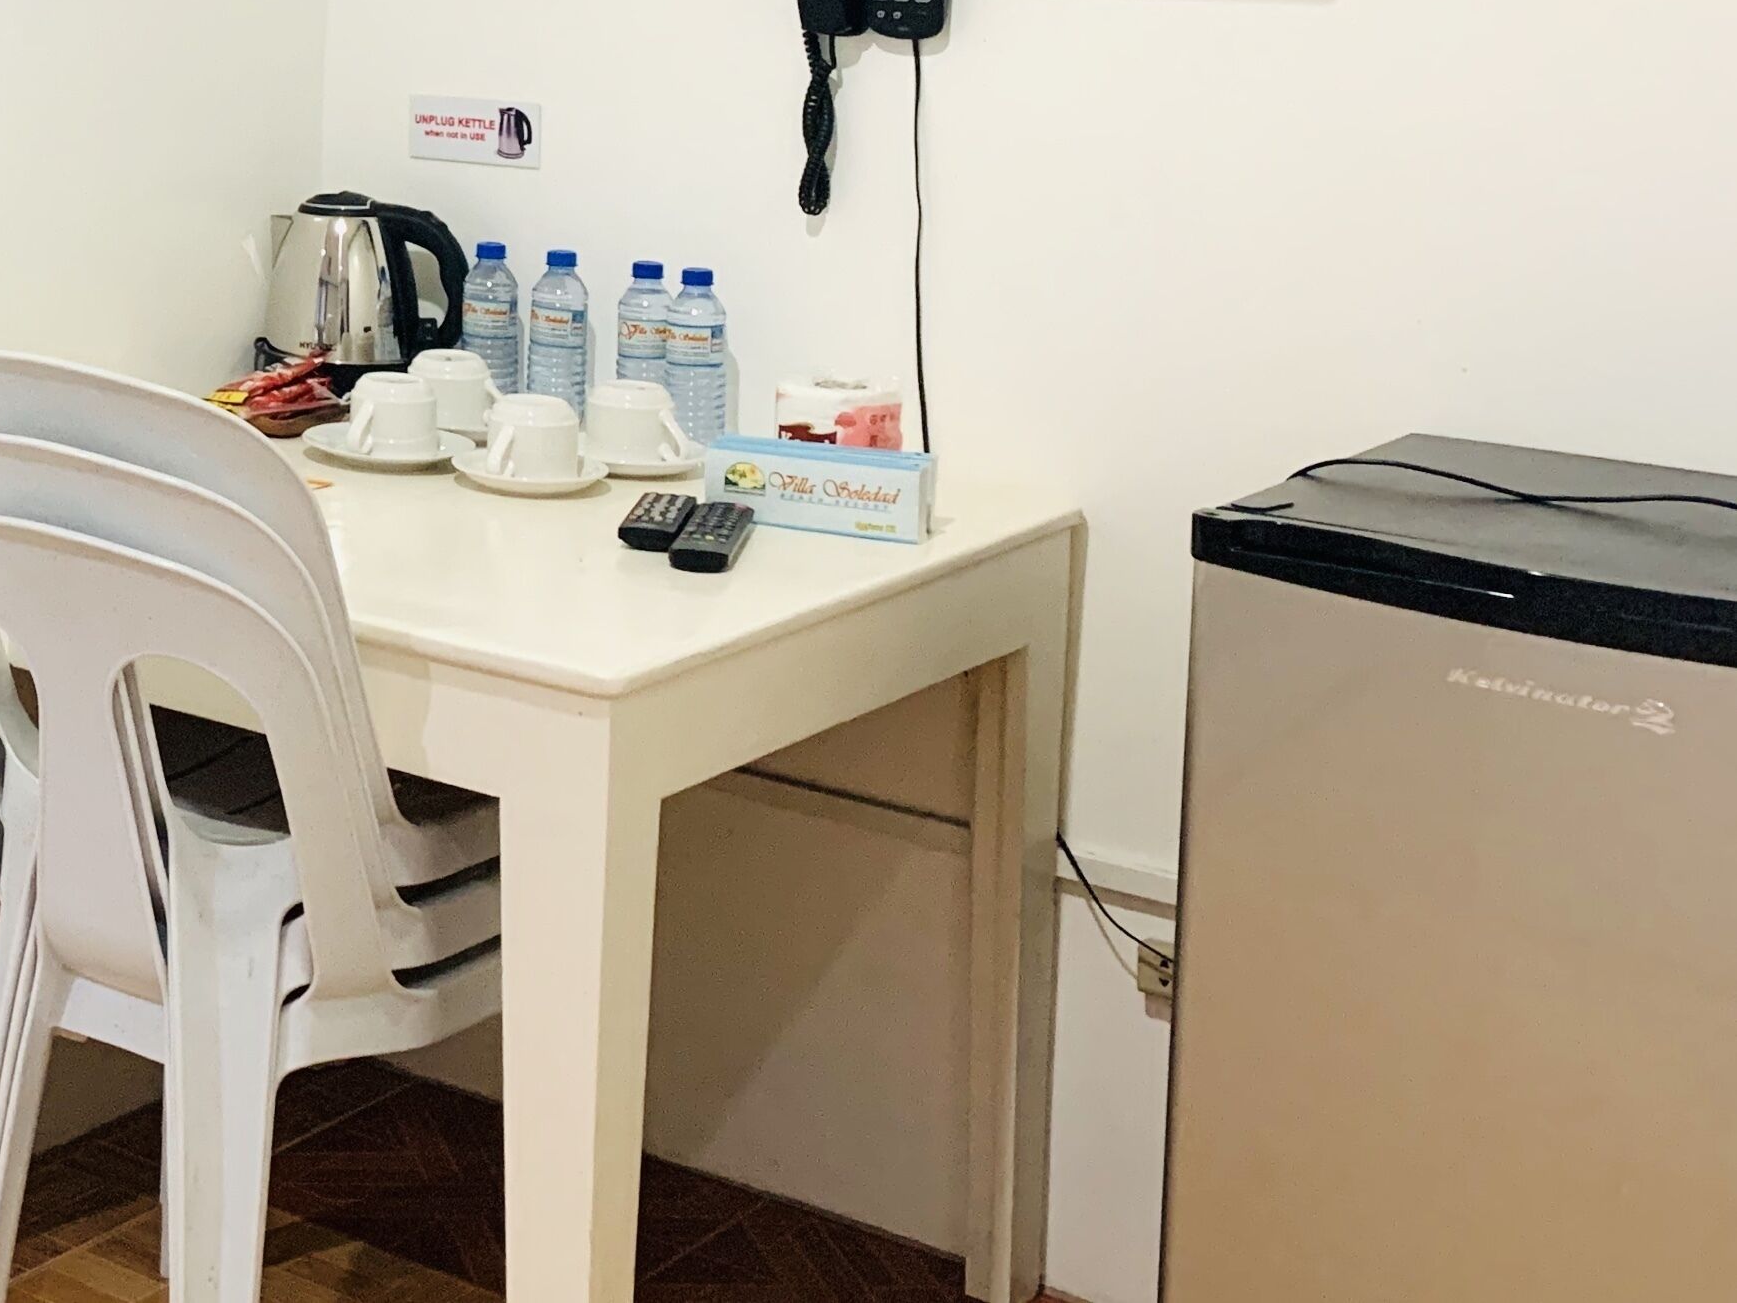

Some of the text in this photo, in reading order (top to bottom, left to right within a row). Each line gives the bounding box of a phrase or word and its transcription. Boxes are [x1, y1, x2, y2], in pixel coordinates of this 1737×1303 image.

[415, 114, 495, 130] UNPLUG KETTLE
[446, 131, 459, 139] not
[469, 132, 486, 141] USE
[768, 471, 901, 505] Villa Soledad
[1447, 668, 1630, 714] Kelvinator
